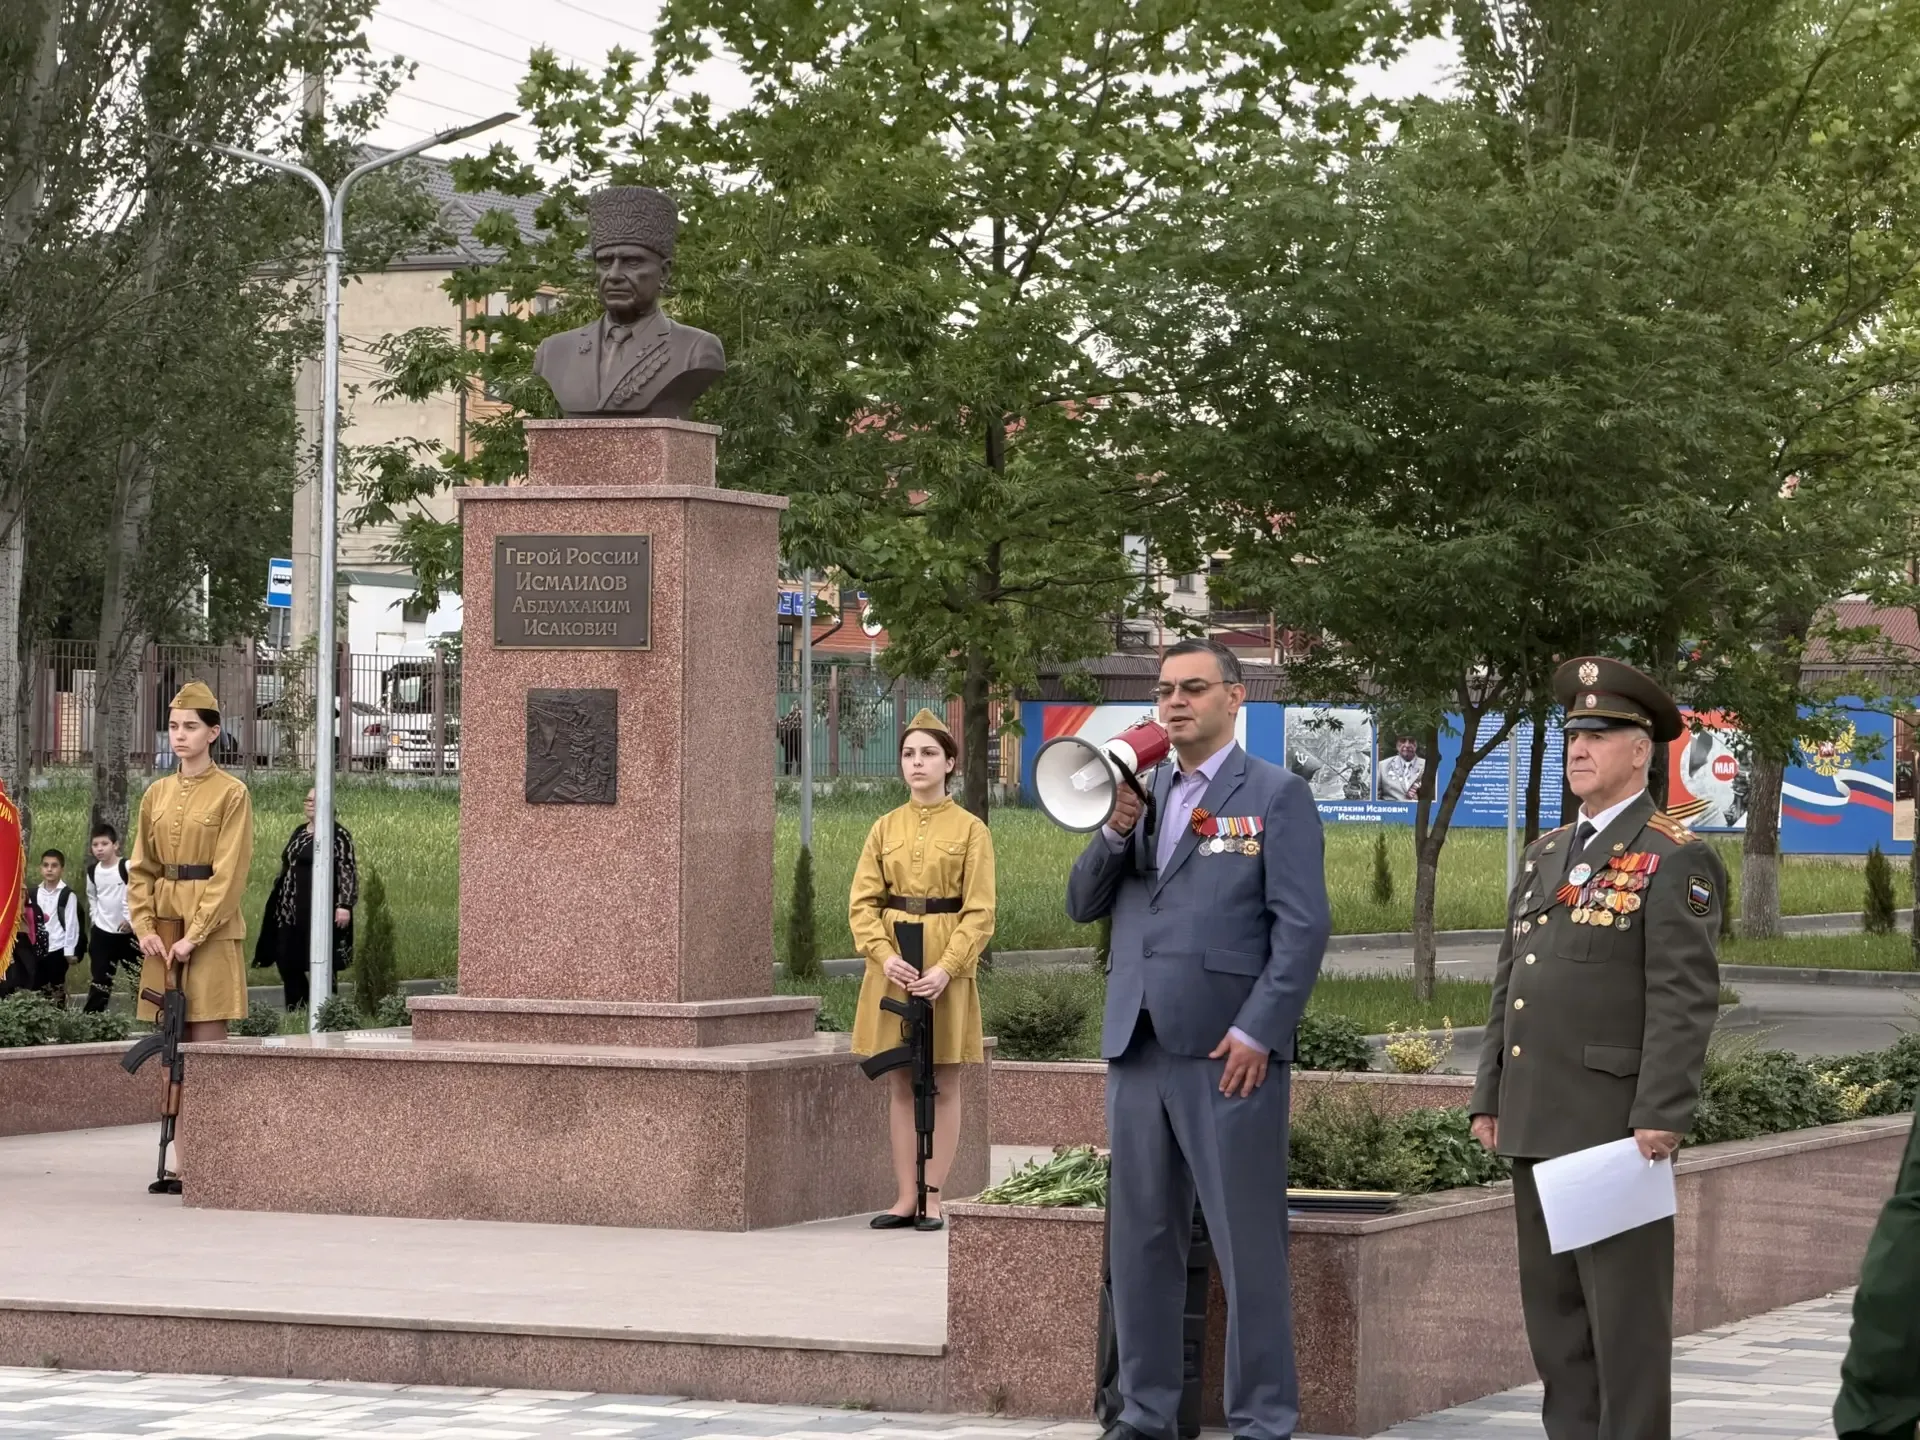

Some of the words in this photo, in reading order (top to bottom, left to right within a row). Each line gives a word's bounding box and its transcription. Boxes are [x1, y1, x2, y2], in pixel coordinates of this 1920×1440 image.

[505, 547, 561, 565] ГЕРОЙ
[566, 547, 639, 565] РОССИИ
[516, 571, 627, 591] ИСМАИЛОВ
[512, 596, 630, 614] АБДУЛХАКИМ
[524, 618, 617, 636] ИСАКОВИЧ
[1714, 762, 1735, 774] МАЯ
[1317, 804, 1364, 813] бдулхаким
[1366, 804, 1408, 813] Исакович
[1338, 813, 1381, 821] Исмаилов
